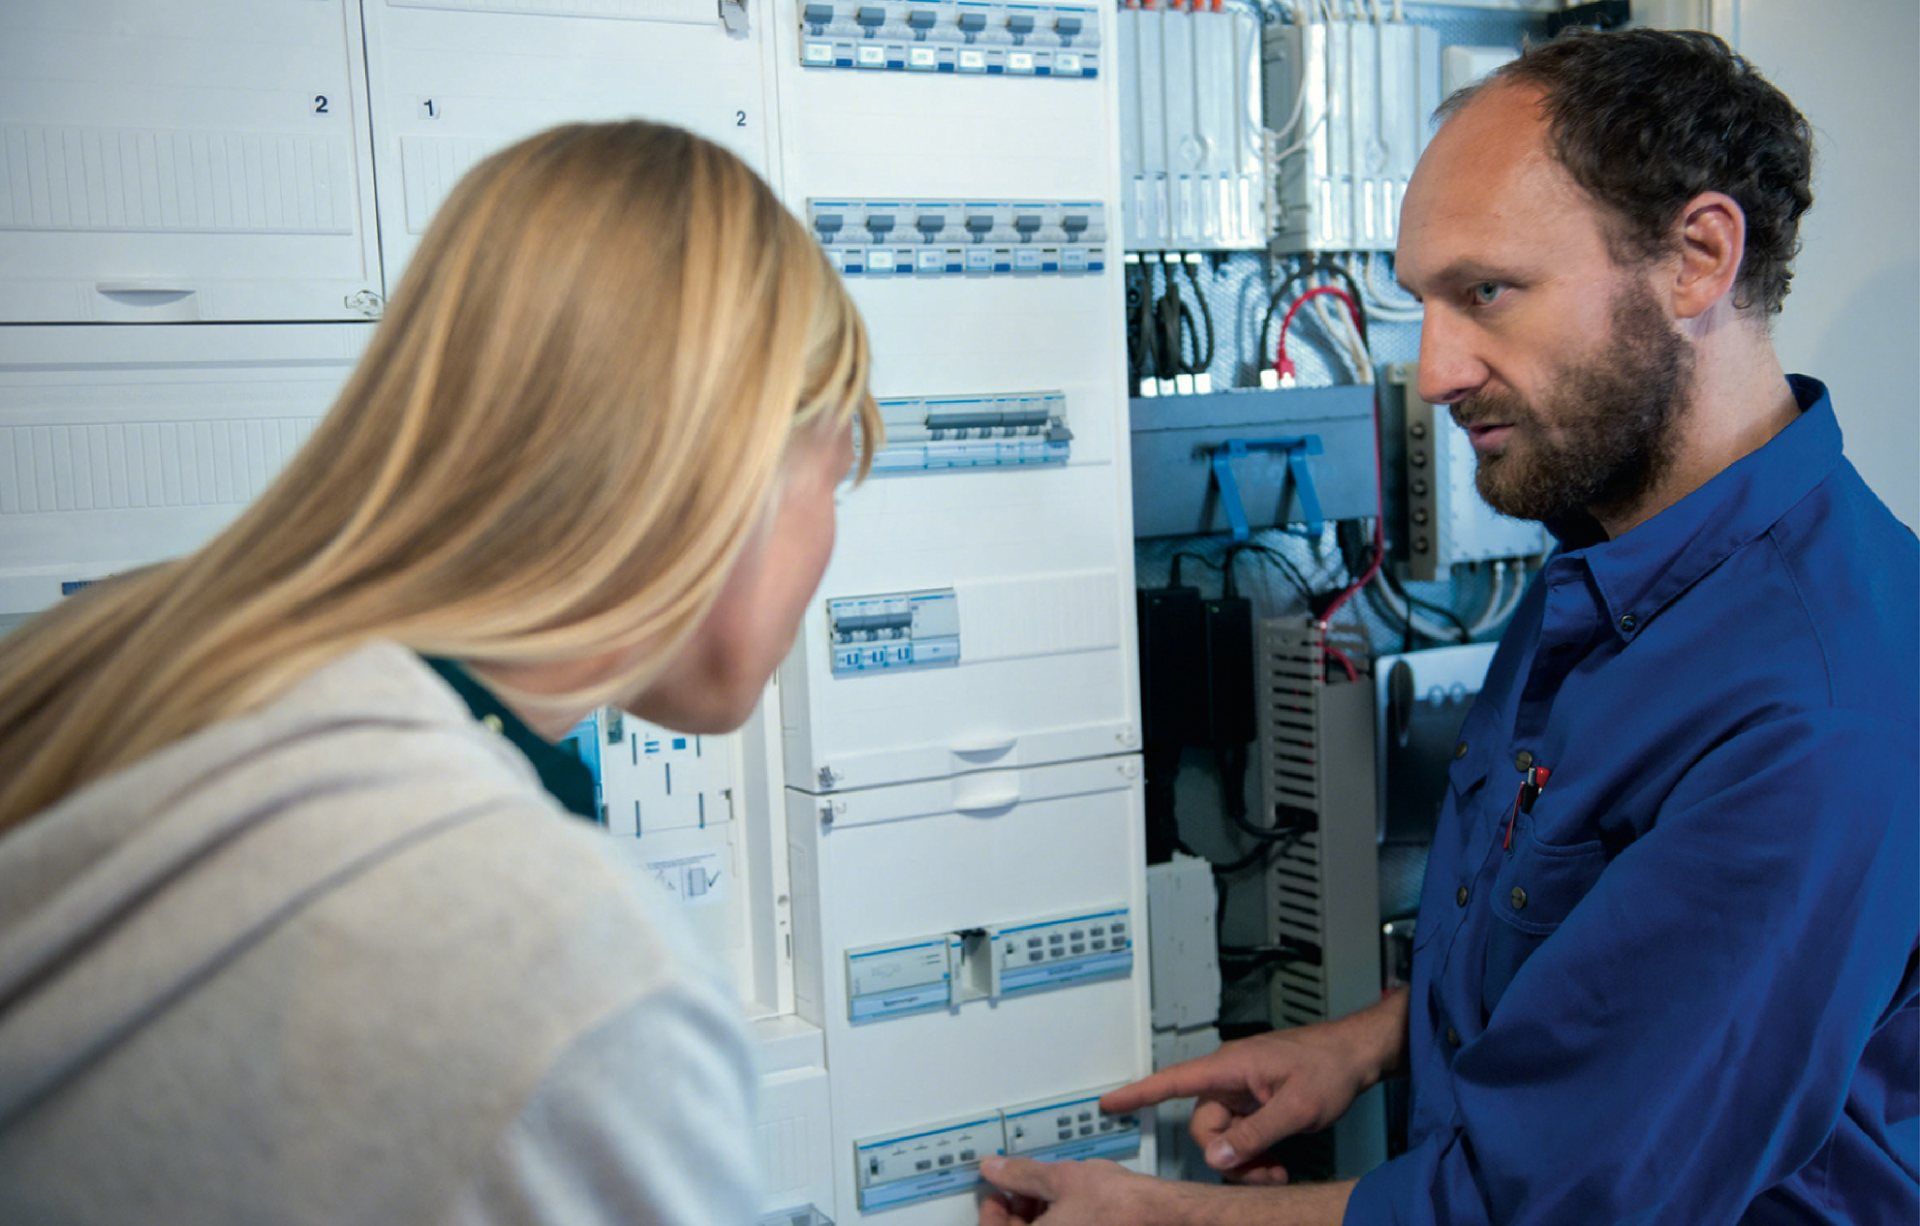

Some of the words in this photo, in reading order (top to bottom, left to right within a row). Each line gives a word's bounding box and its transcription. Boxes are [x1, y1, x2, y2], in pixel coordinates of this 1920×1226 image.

[315, 95, 328, 114] 2
[423, 99, 433, 117] 1
[736, 110, 746, 127] 2
